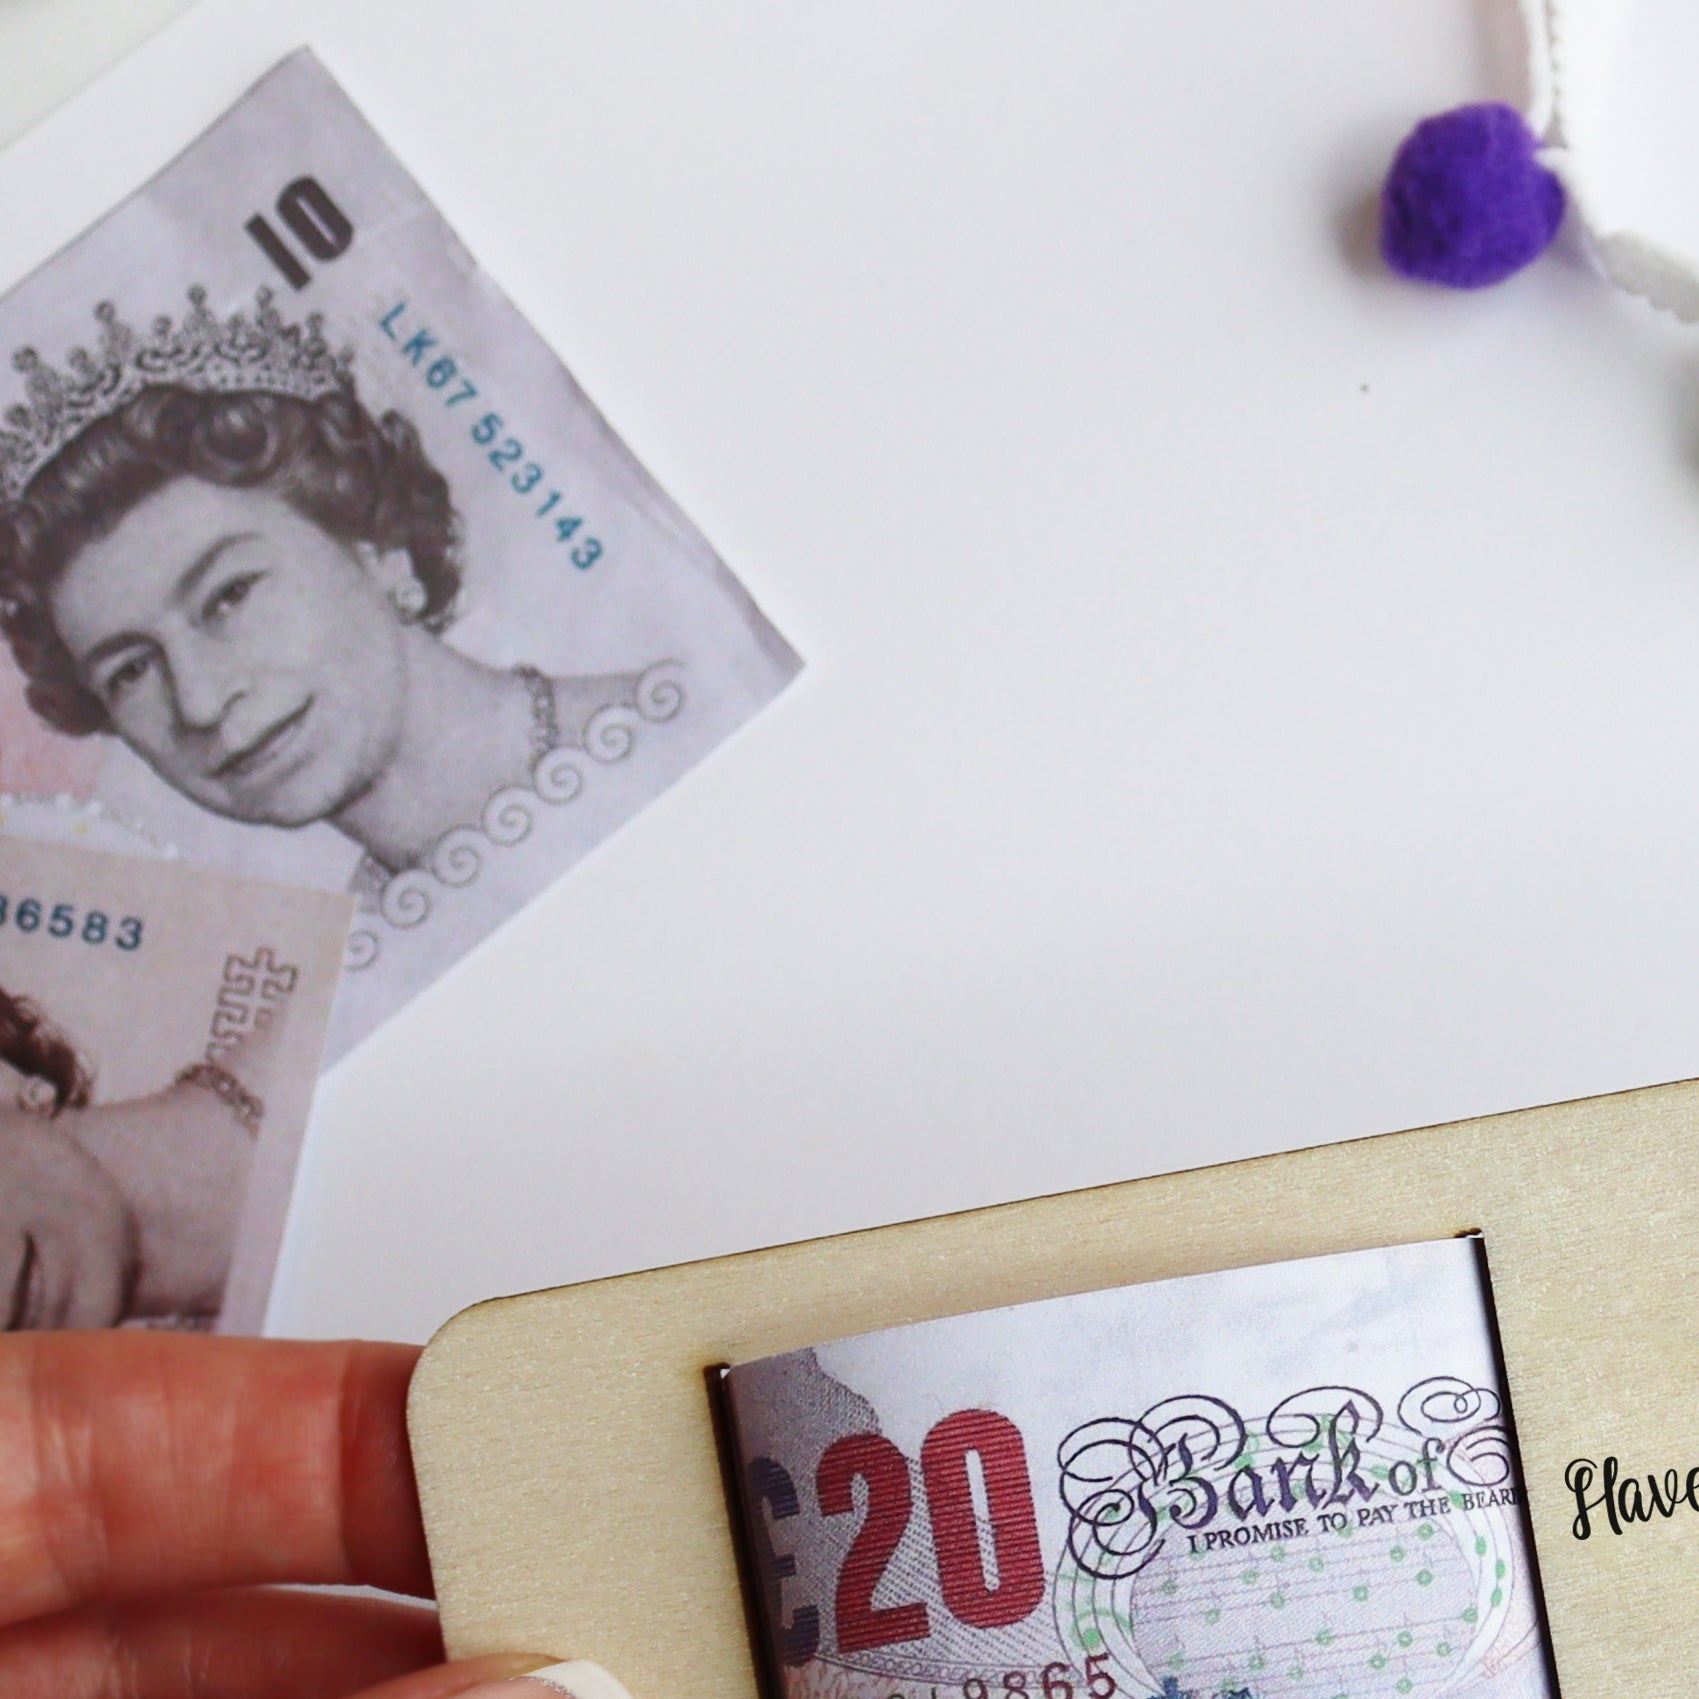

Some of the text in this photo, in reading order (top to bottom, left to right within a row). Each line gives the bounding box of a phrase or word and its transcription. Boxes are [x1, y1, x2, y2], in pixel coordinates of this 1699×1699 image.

[245, 175, 354, 290] 10
[379, 302, 603, 571] LK67 523143
[1388, 1438, 1446, 1495] of
[1199, 1518, 1310, 1549] PROMISE
[1317, 1510, 1348, 1533] TO
[1357, 1503, 1400, 1529] PAY
[1403, 1498, 1452, 1522] THE
